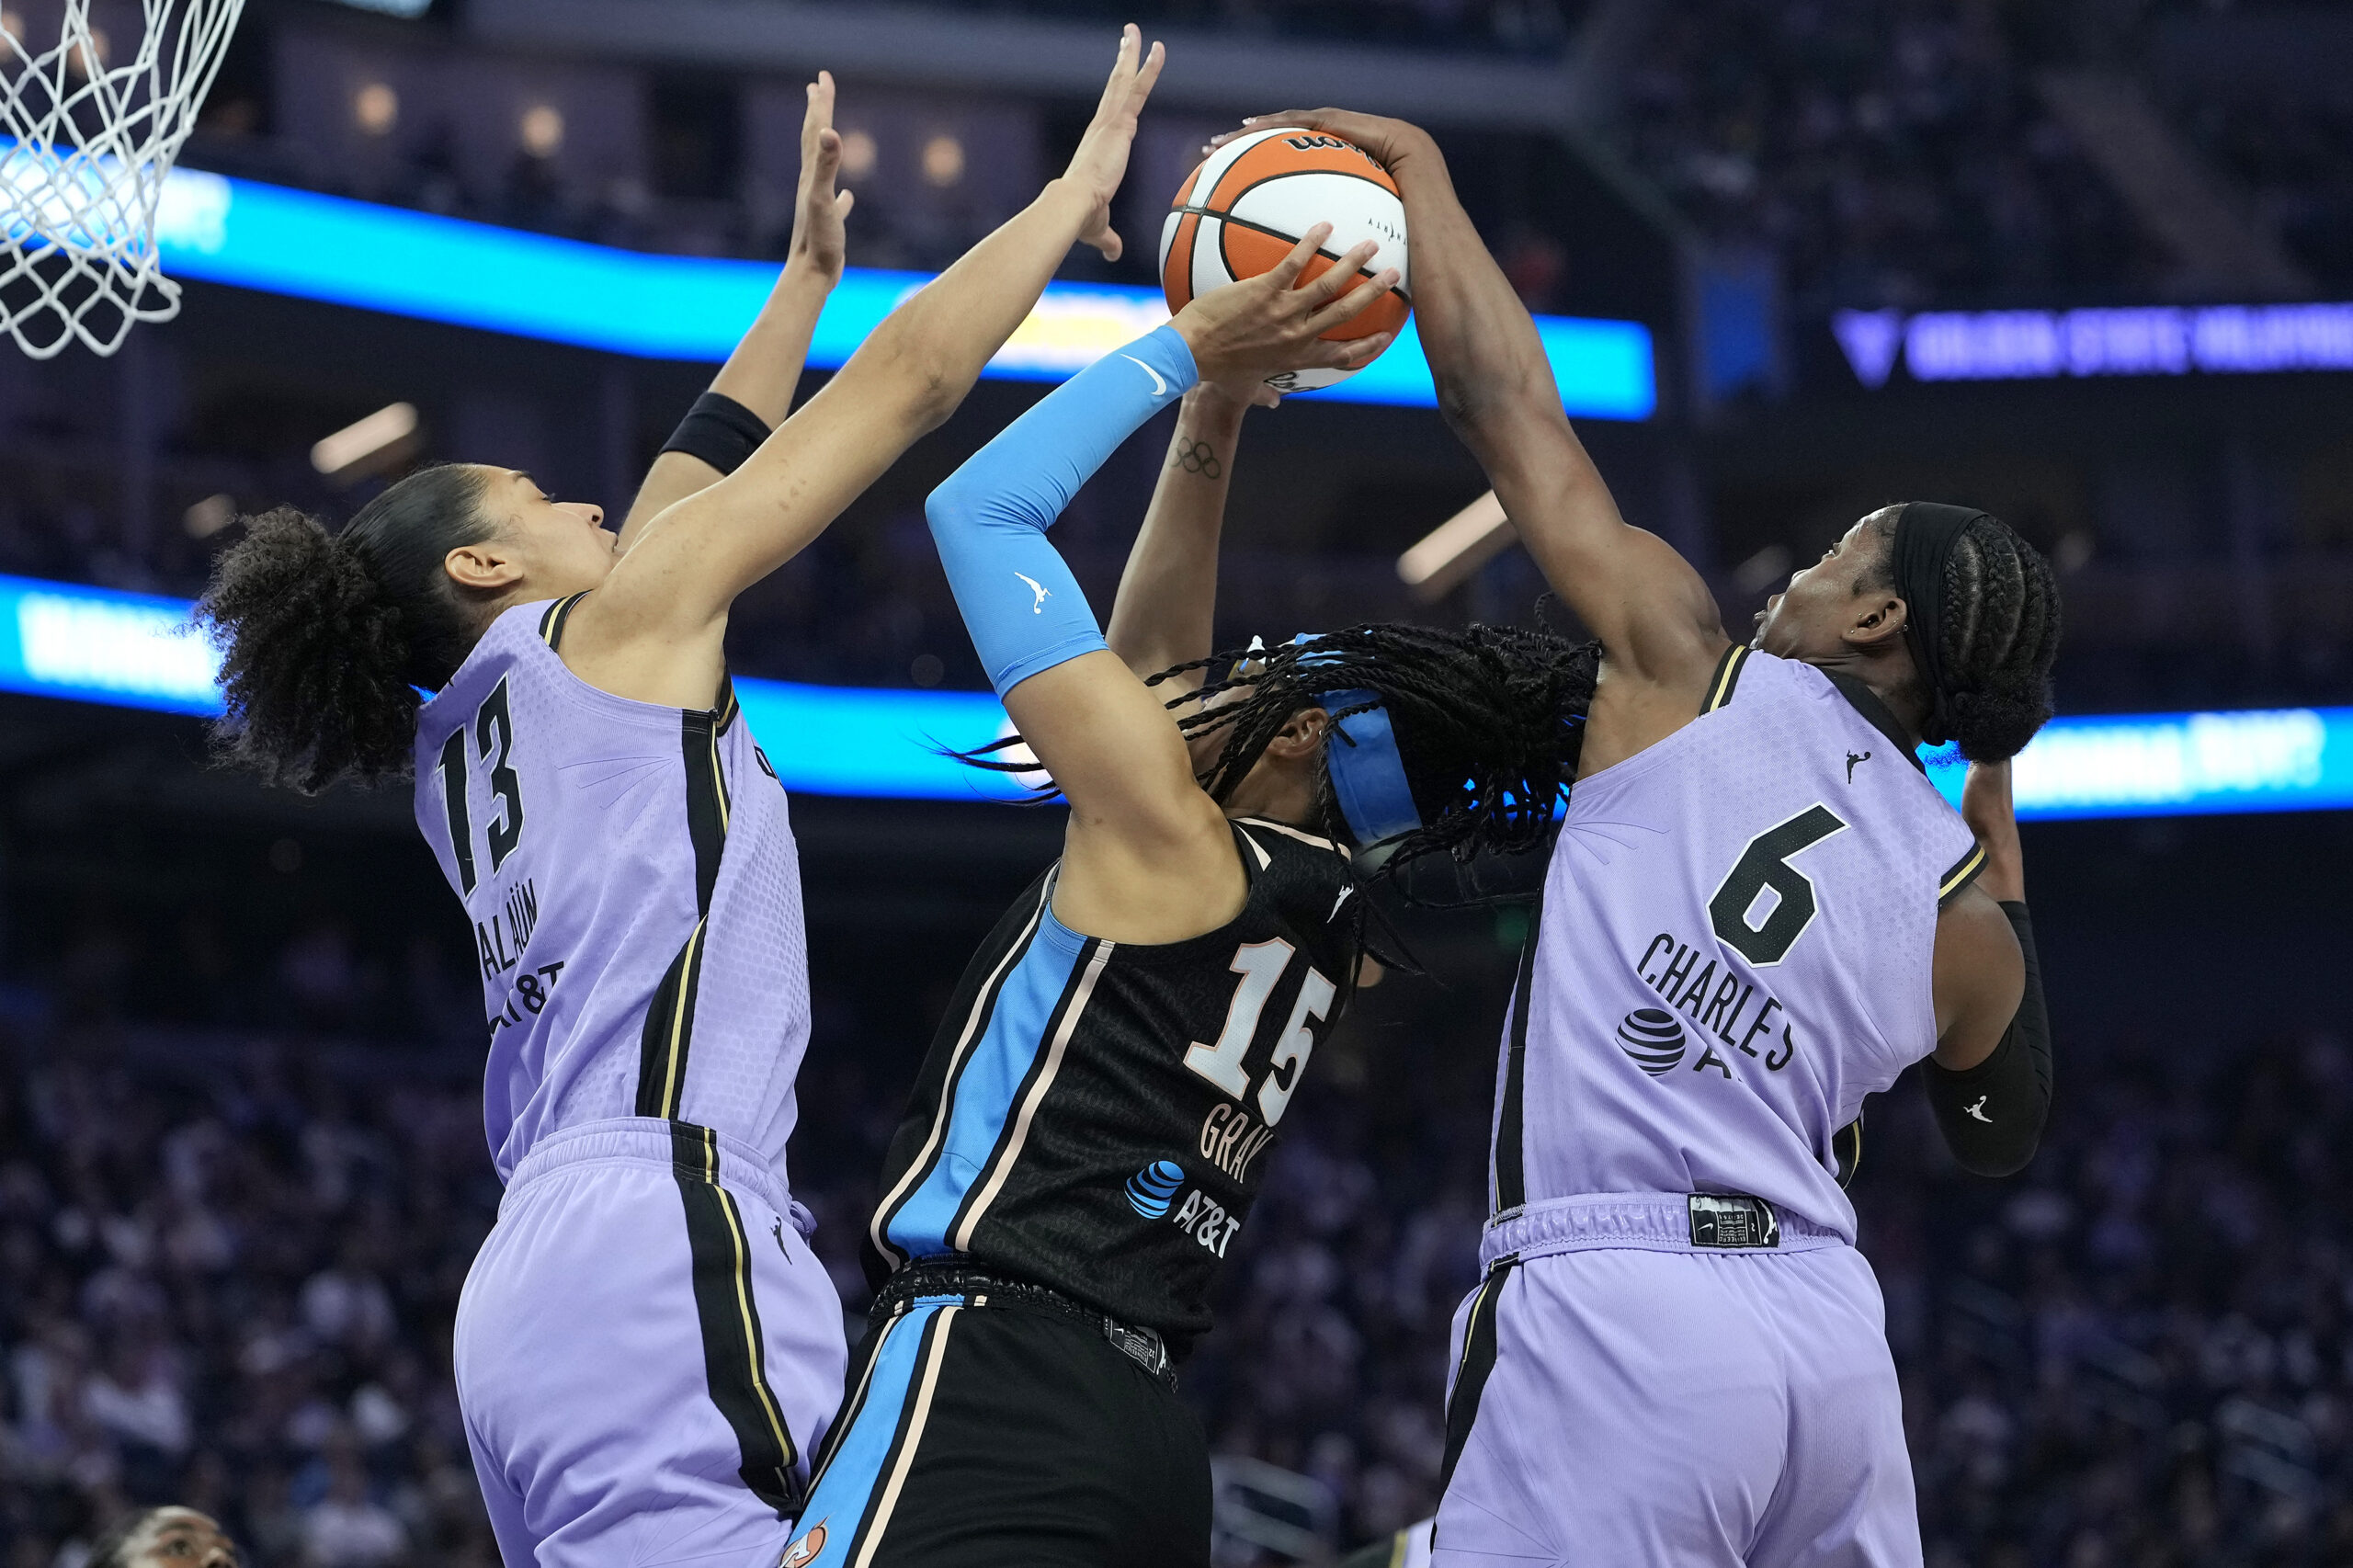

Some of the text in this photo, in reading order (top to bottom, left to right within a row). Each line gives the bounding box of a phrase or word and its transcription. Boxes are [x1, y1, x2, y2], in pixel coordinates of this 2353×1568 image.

[435, 670, 525, 904] 13
[1705, 801, 1851, 968] 6
[1183, 937, 1337, 1128] 15
[1637, 933, 1794, 1072] CHARLES
[1200, 1103, 1274, 1184] GRAY
[1173, 1189, 1240, 1259] AT&T
